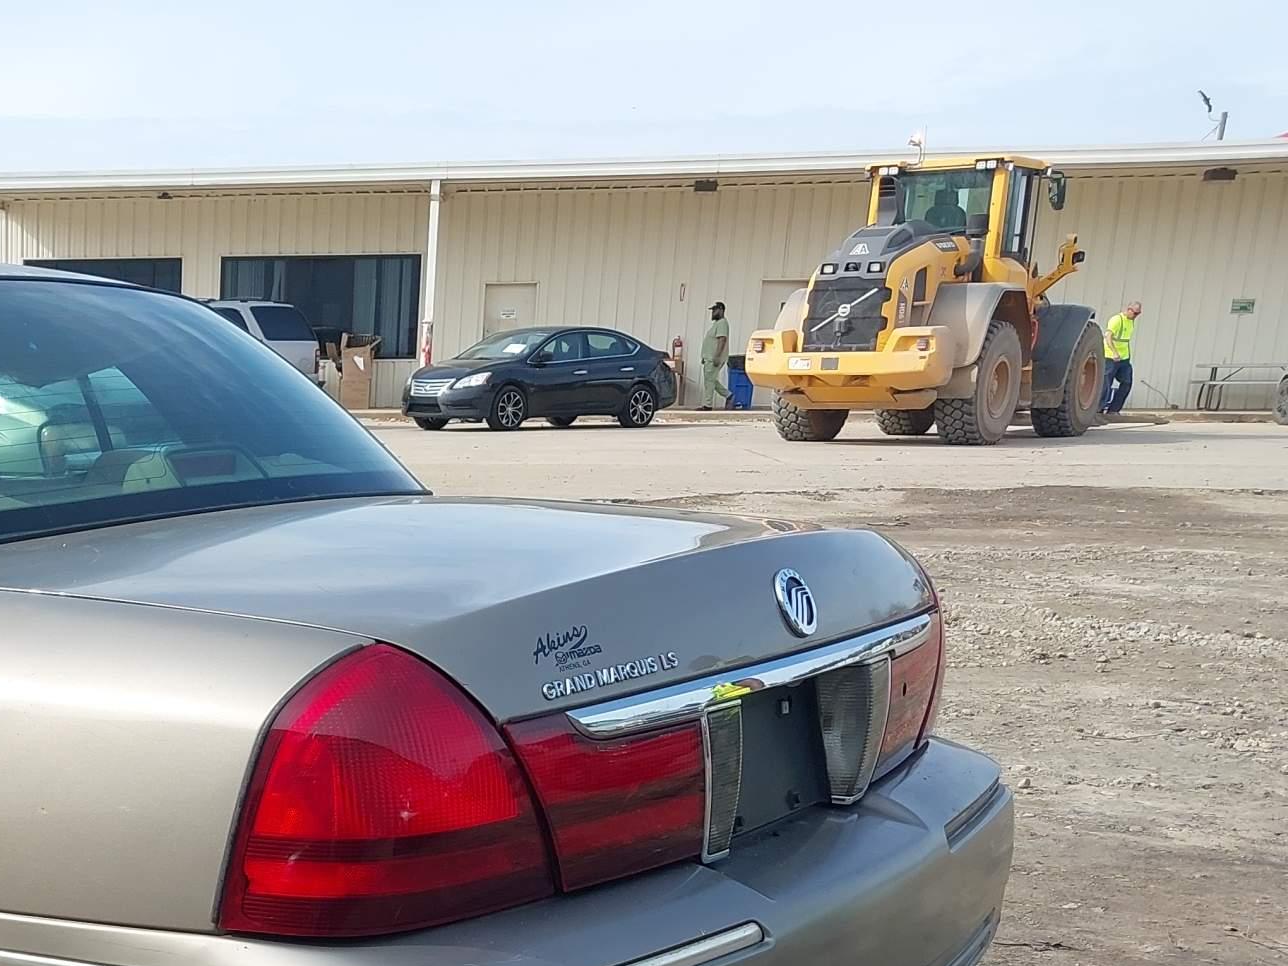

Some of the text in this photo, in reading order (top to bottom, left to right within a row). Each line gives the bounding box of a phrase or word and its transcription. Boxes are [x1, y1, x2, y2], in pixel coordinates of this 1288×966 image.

[533, 625, 588, 664] Akins
[568, 644, 603, 660] mazda
[542, 651, 679, 701] GRAND MARQUIS LS
